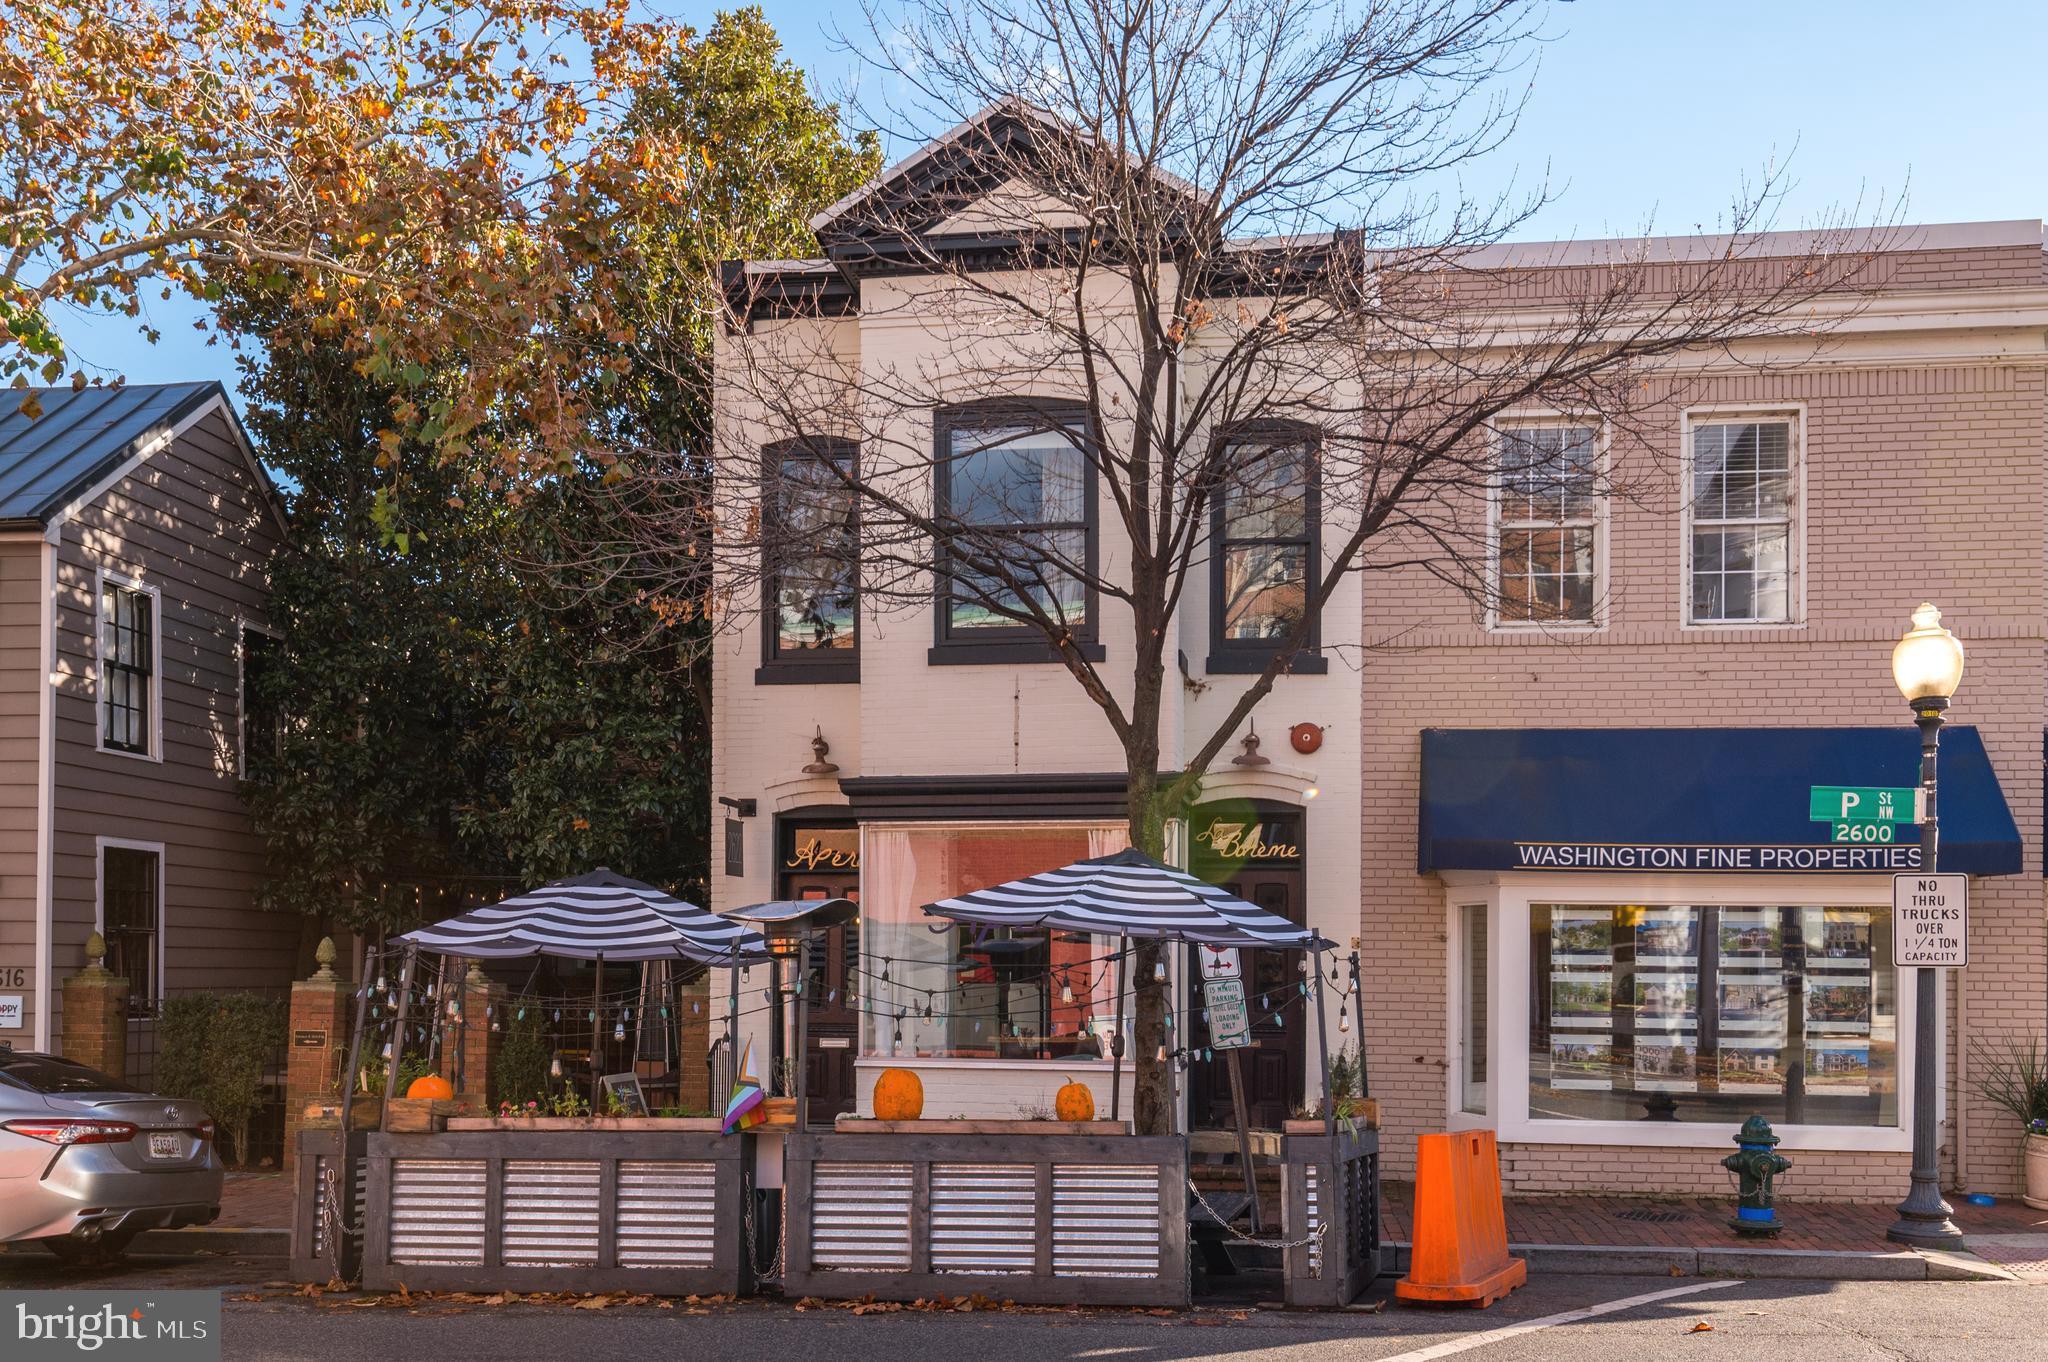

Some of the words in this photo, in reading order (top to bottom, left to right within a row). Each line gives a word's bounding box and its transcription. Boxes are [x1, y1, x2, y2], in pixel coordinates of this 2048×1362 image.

[1841, 792, 1861, 818] P
[1879, 792, 1892, 805] St
[1879, 806, 1894, 819] NW
[1196, 817, 1228, 842] La
[1836, 823, 1892, 842] 2600
[787, 838, 860, 870] Aper
[1519, 846, 1687, 867] WASHINGTON
[1696, 848, 1752, 868] FINE
[1760, 848, 1921, 868] PROPERTIES
[1918, 880, 1937, 892] NO
[1911, 895, 1945, 906] THRU
[1901, 909, 1960, 920] TRUCKS
[1916, 923, 1943, 934] OVER
[1938, 938, 1958, 949] TON
[1905, 952, 1957, 961] CAPACITY
[1212, 994, 1238, 1003] PARKING
[1215, 1013, 1240, 1023] LOADING
[1221, 1022, 1236, 1030] ONLY
